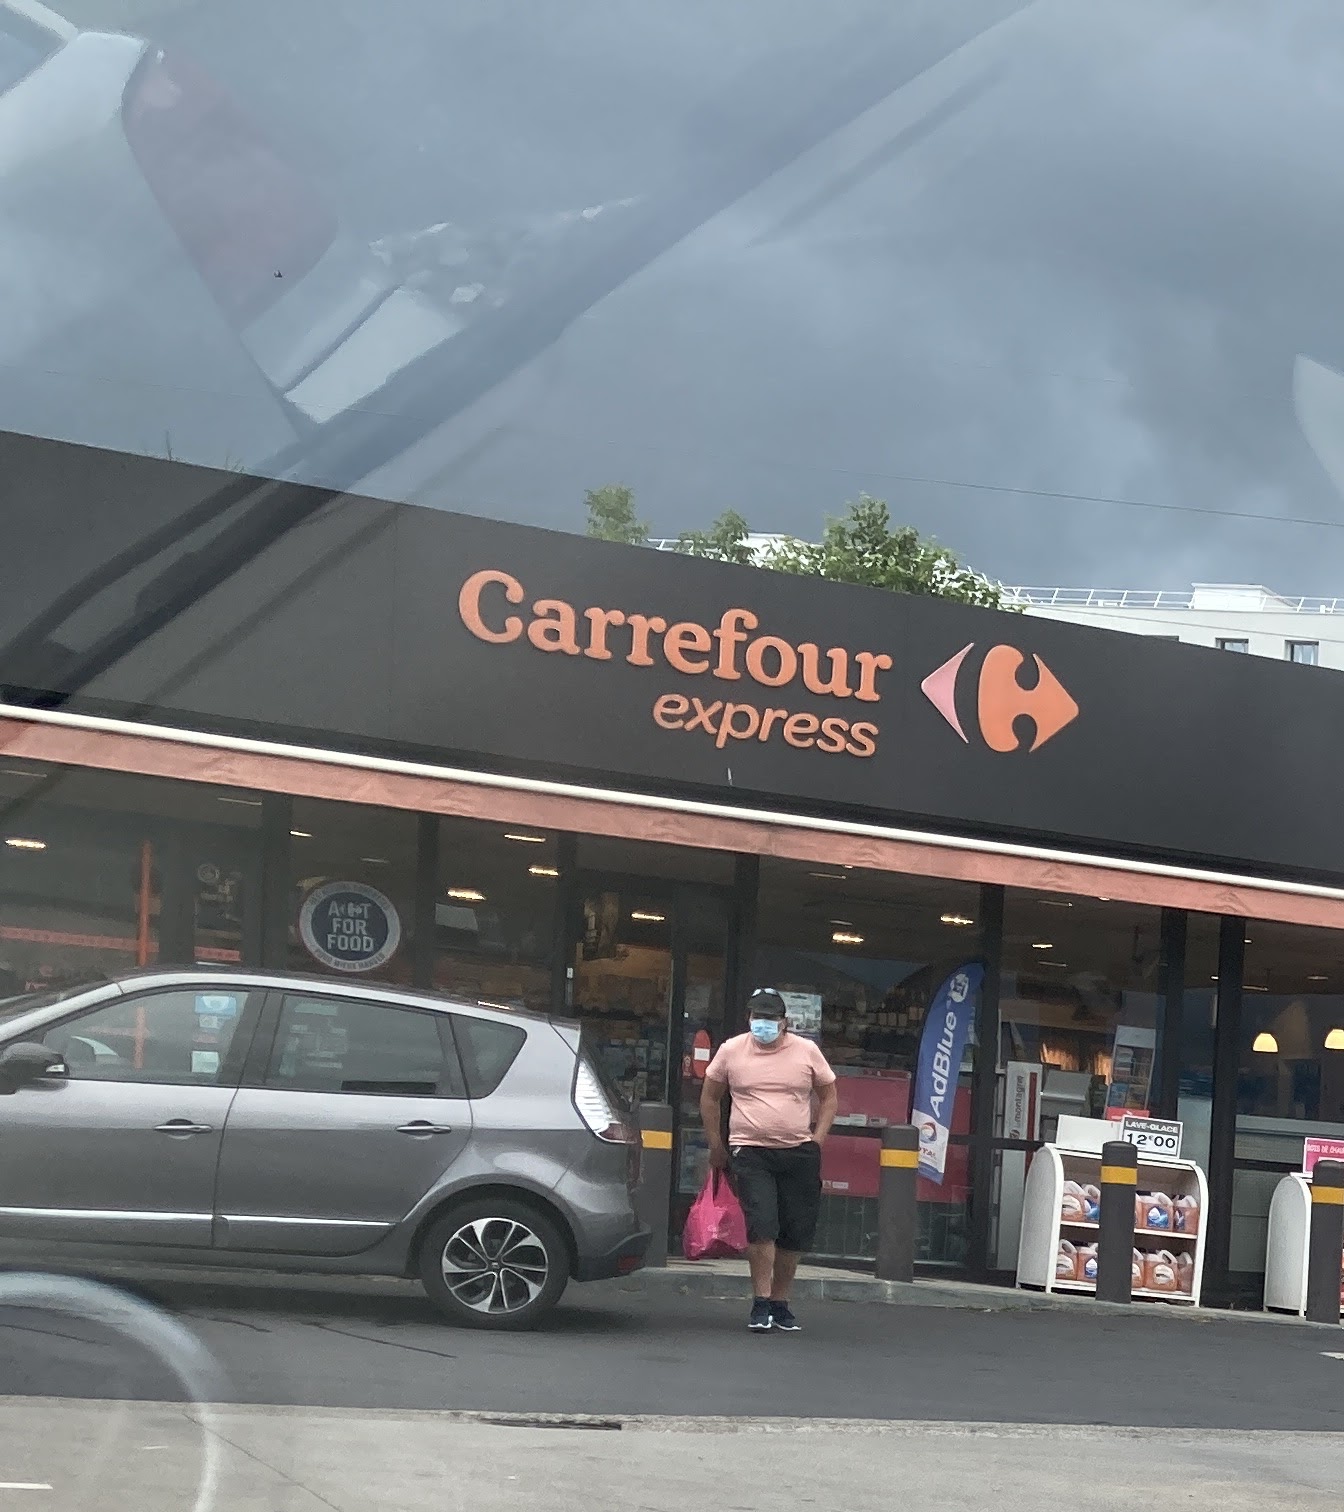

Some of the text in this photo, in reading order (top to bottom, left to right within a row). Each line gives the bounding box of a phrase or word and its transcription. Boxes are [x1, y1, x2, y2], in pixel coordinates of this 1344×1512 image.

[459, 569, 892, 702] Carrefour
[653, 692, 878, 757] express
[332, 918, 368, 935] FOR
[327, 934, 374, 952] FOOD
[930, 1012, 957, 1118] AdBlue
[1125, 1120, 1178, 1133] LAVE-GLACE
[1321, 1145, 1329, 1154] DE
